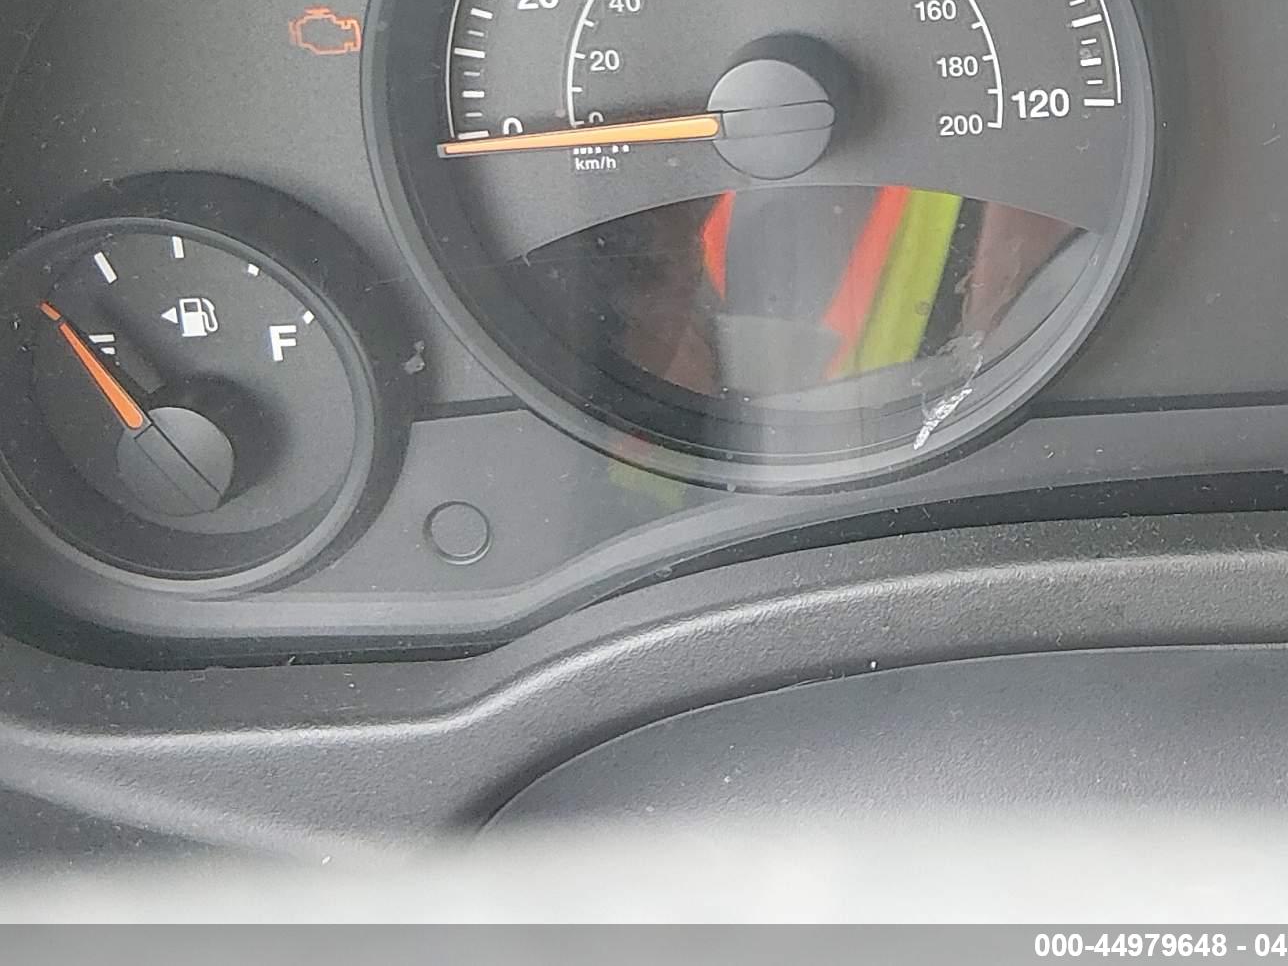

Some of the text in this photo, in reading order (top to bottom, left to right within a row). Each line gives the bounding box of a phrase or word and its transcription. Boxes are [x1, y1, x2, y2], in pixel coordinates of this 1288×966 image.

[914, 0, 957, 22] 160
[589, 49, 620, 72] 20
[936, 55, 979, 78] 180
[1010, 88, 1070, 119] 120
[939, 113, 983, 136] 200
[572, 154, 619, 171] km/h
[268, 324, 297, 362] F
